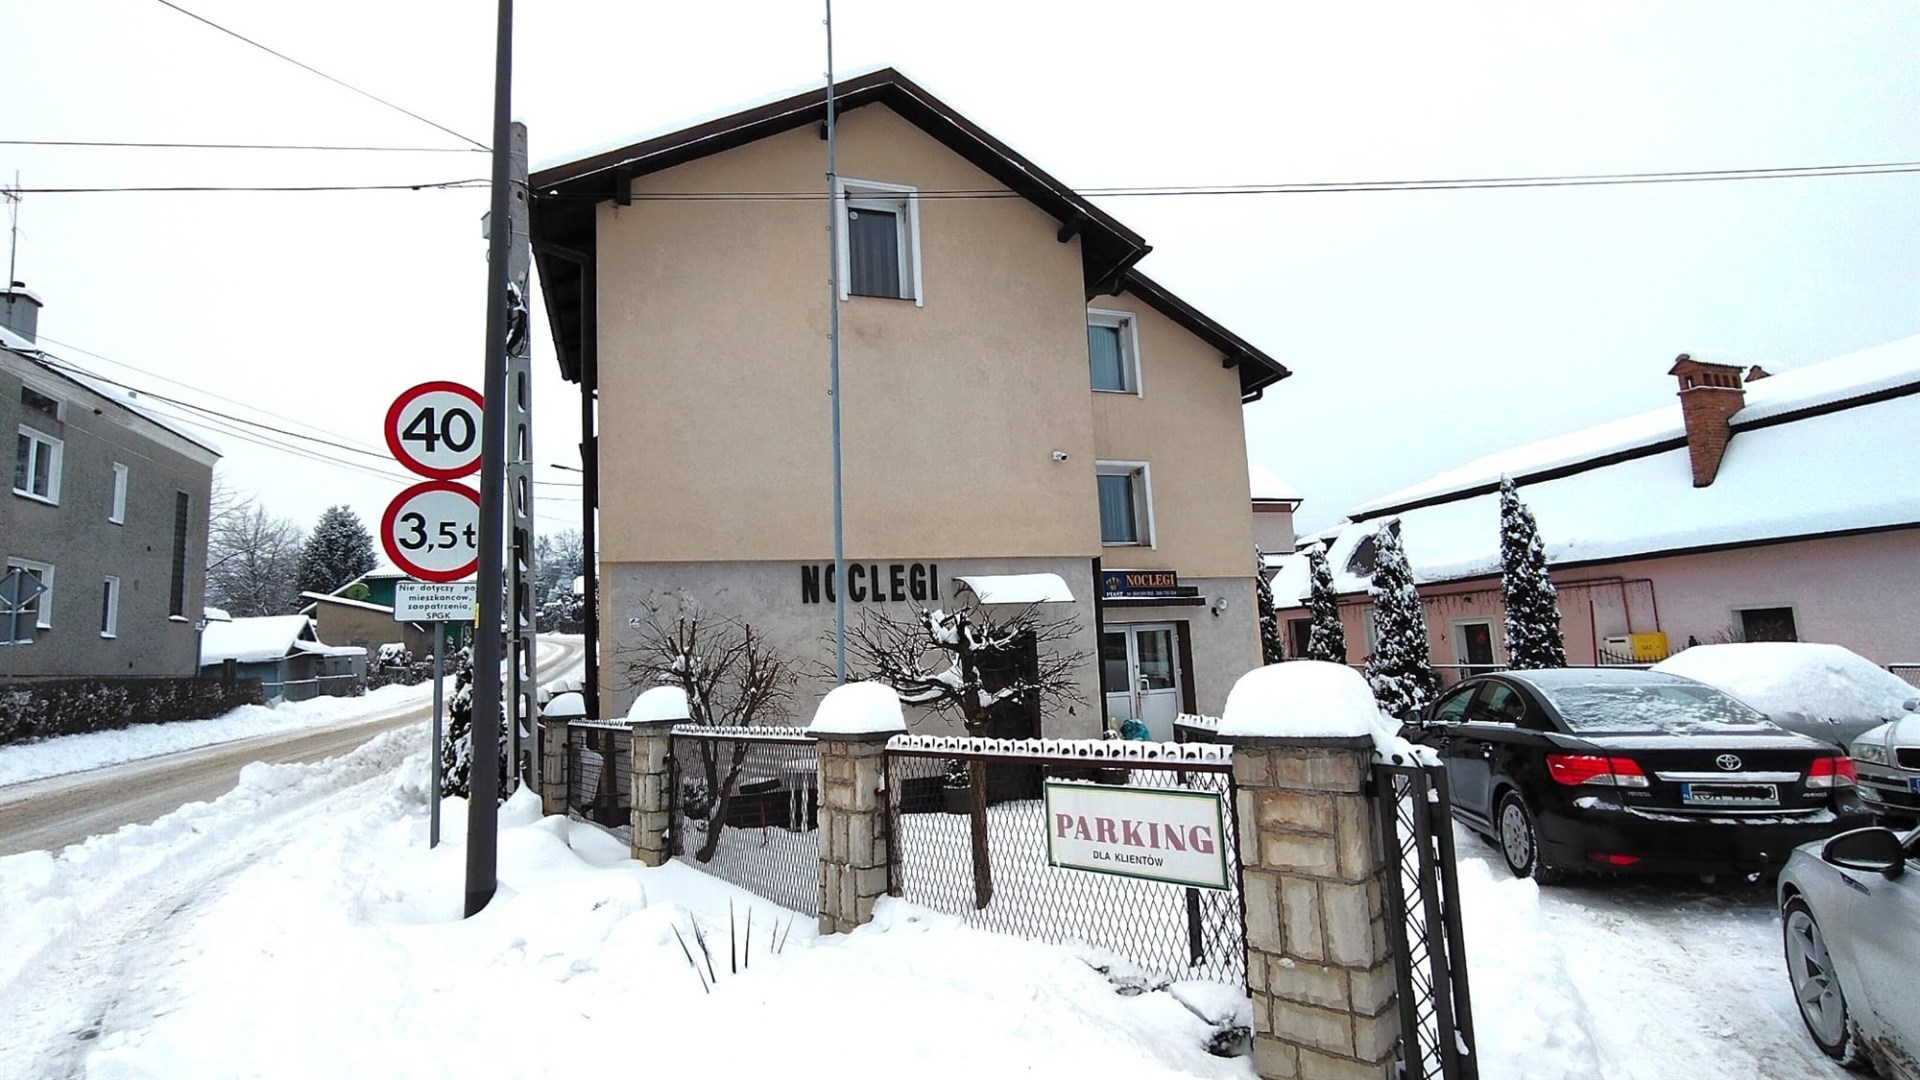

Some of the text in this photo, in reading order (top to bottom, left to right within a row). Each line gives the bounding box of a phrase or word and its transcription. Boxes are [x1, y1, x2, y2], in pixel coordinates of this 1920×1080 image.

[402, 407, 476, 452] 40
[801, 563, 939, 603] NOCLEGI
[1126, 574, 1175, 587] NOCLEGI
[420, 585, 455, 594] dotyczy
[408, 602, 472, 611] zaopatrzenia,
[426, 612, 451, 620] SPGK
[1055, 813, 1215, 854] PARKING
[1093, 850, 1164, 867] DLA KLIENTÓW
